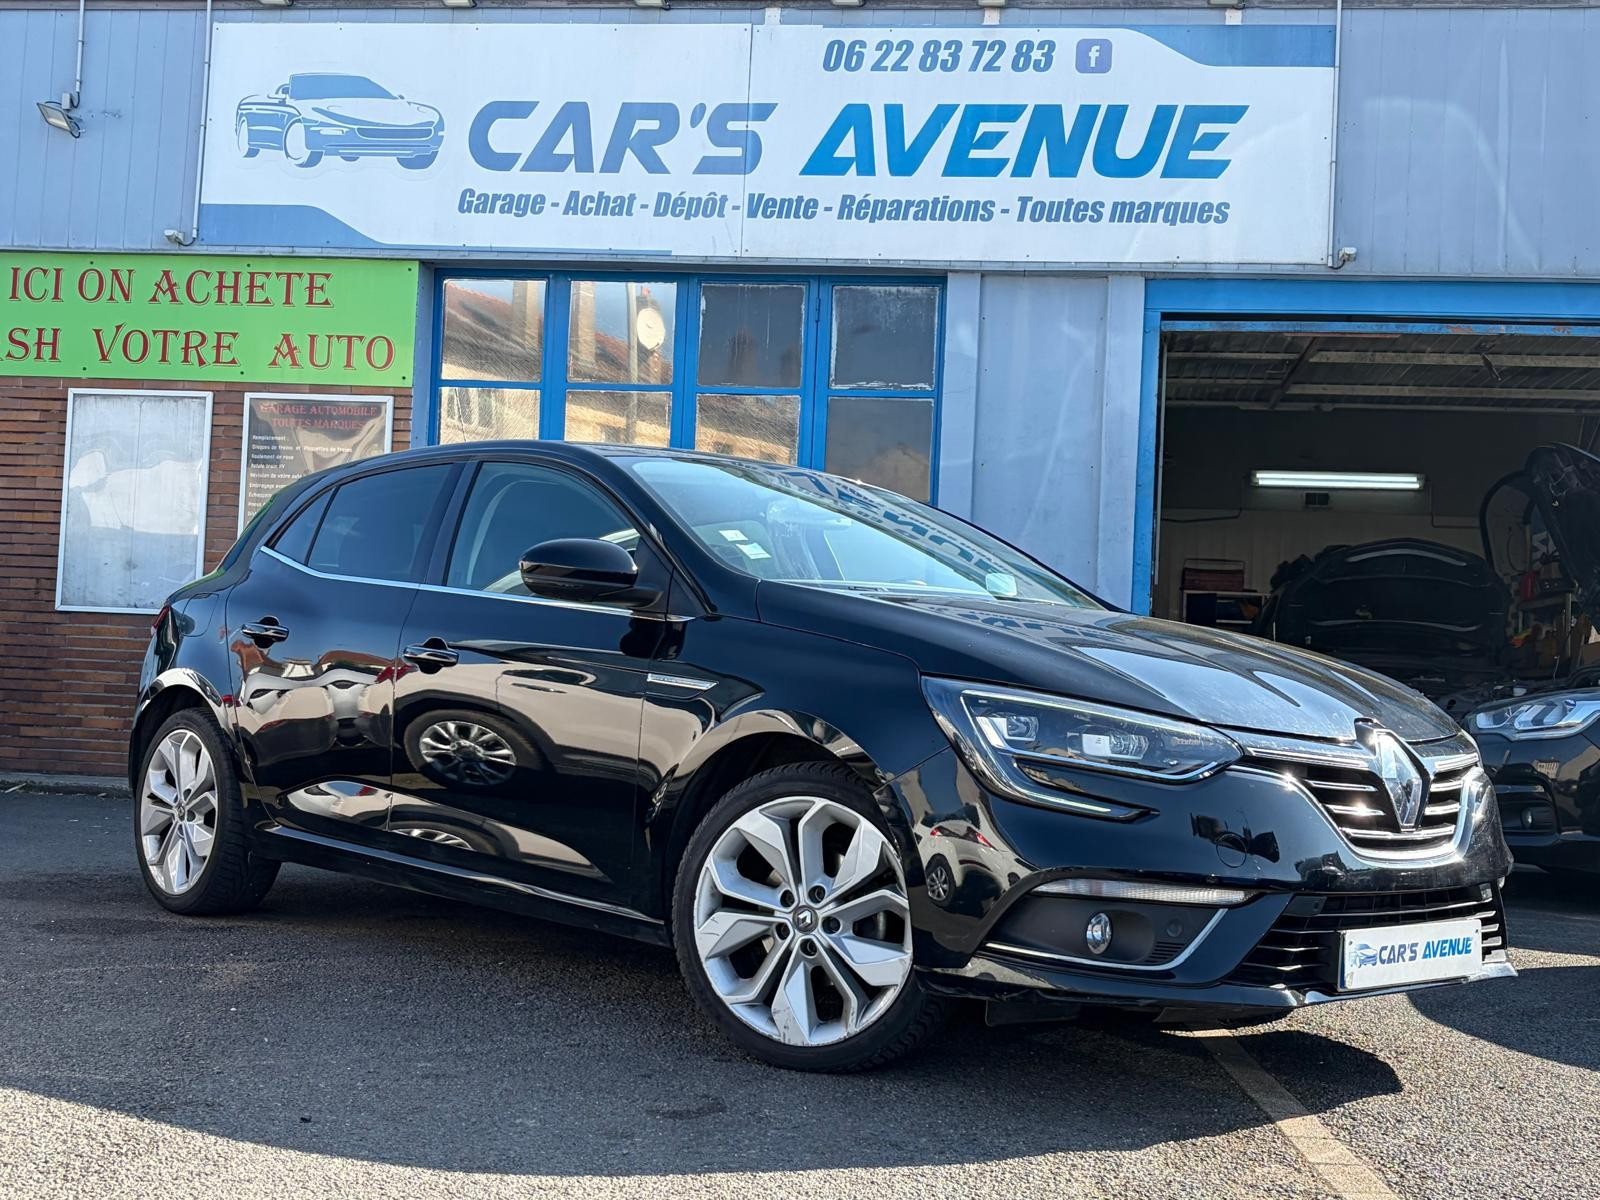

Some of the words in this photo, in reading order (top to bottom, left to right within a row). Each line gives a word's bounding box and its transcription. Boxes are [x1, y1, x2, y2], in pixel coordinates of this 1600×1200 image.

[822, 39, 865, 72] 06
[870, 39, 914, 72] 22
[918, 39, 961, 72] 83
[967, 40, 1009, 72] 72
[1010, 40, 1056, 73] 83
[468, 100, 779, 175] CAR'S
[798, 103, 1250, 179] AVENUE
[457, 188, 546, 218] Garage
[563, 190, 637, 217] Achat
[653, 191, 729, 220] Dépôt
[747, 193, 818, 220] Vente
[836, 194, 996, 224] Réparations
[1016, 196, 1105, 224] Toutes
[1109, 197, 1231, 227] marques
[8, 266, 64, 303] ICI
[77, 267, 136, 303] ON
[148, 268, 334, 309] ACHETE
[0, 326, 62, 363] SH
[92, 321, 242, 369] VOTRE
[267, 332, 396, 372] AUTO
[260, 403, 306, 415] GARAGE
[309, 404, 377, 416] AUTOMOBILE
[313, 418, 367, 430] MARQUES
[1379, 942, 1419, 965] CAR'S
[1422, 936, 1473, 960] AVENUE
